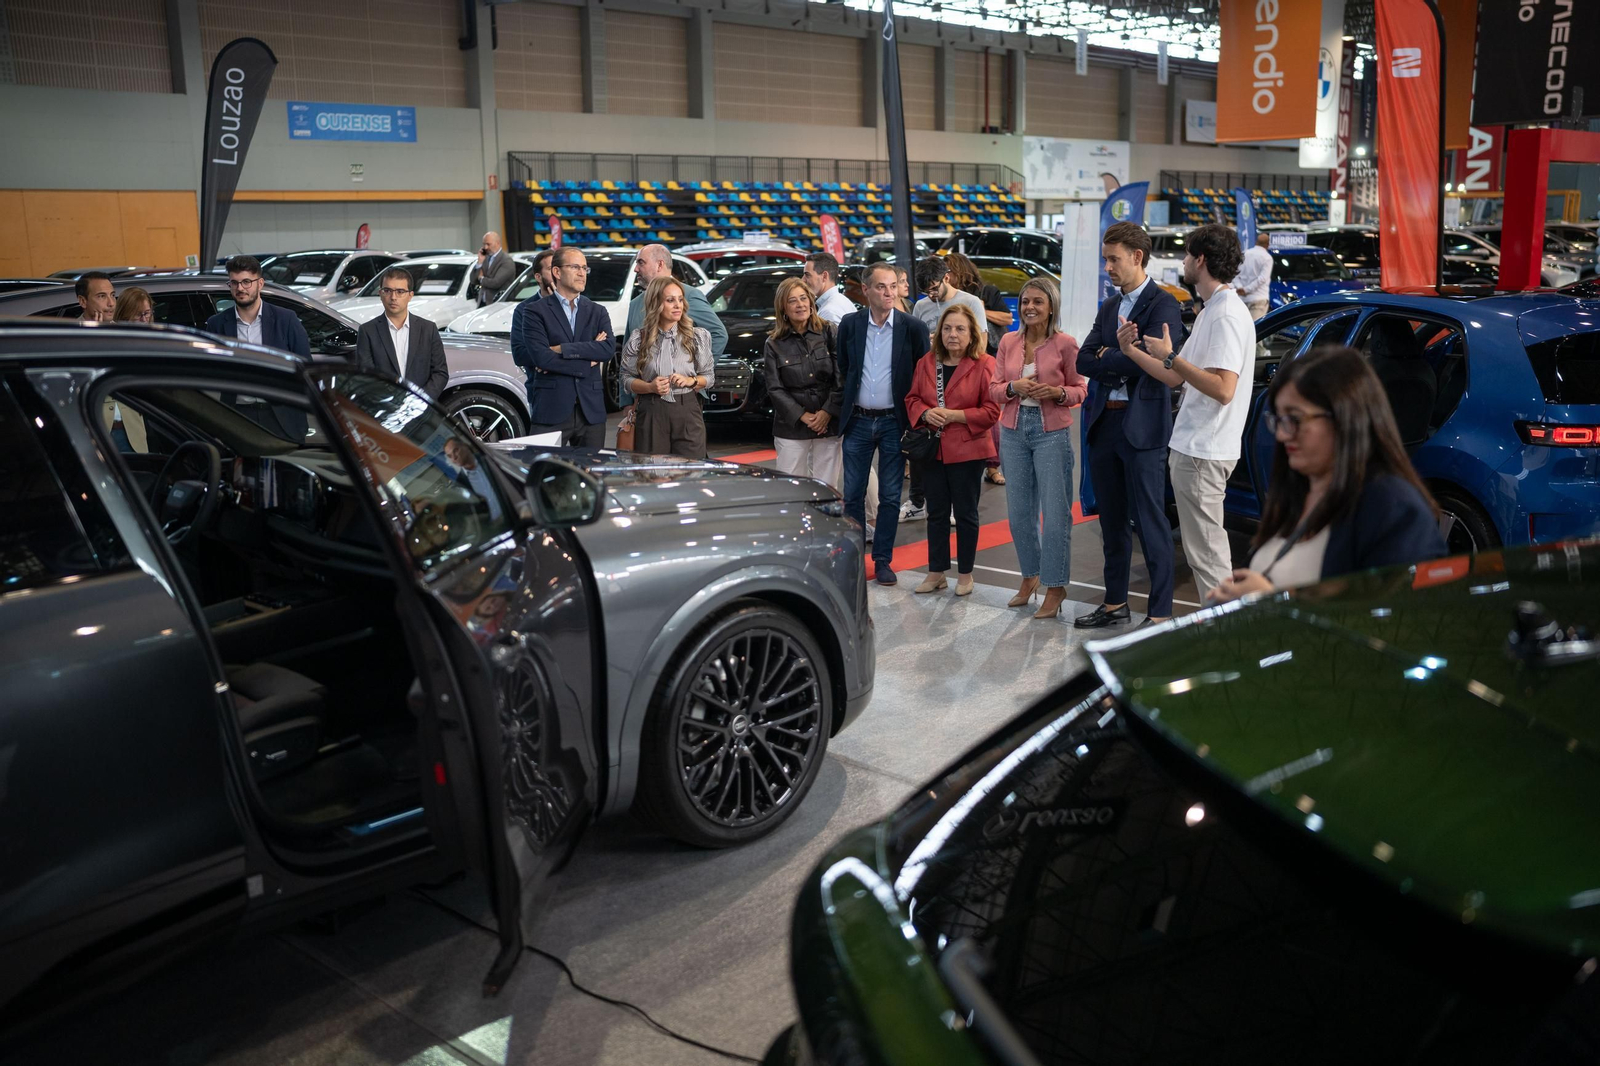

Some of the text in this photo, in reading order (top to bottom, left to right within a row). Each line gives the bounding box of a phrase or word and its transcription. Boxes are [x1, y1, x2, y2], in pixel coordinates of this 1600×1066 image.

[212, 66, 245, 166] Louzao
[316, 112, 392, 133] OURENSE
[1336, 48, 1353, 195] NISSAN
[1350, 160, 1371, 169] MINI
